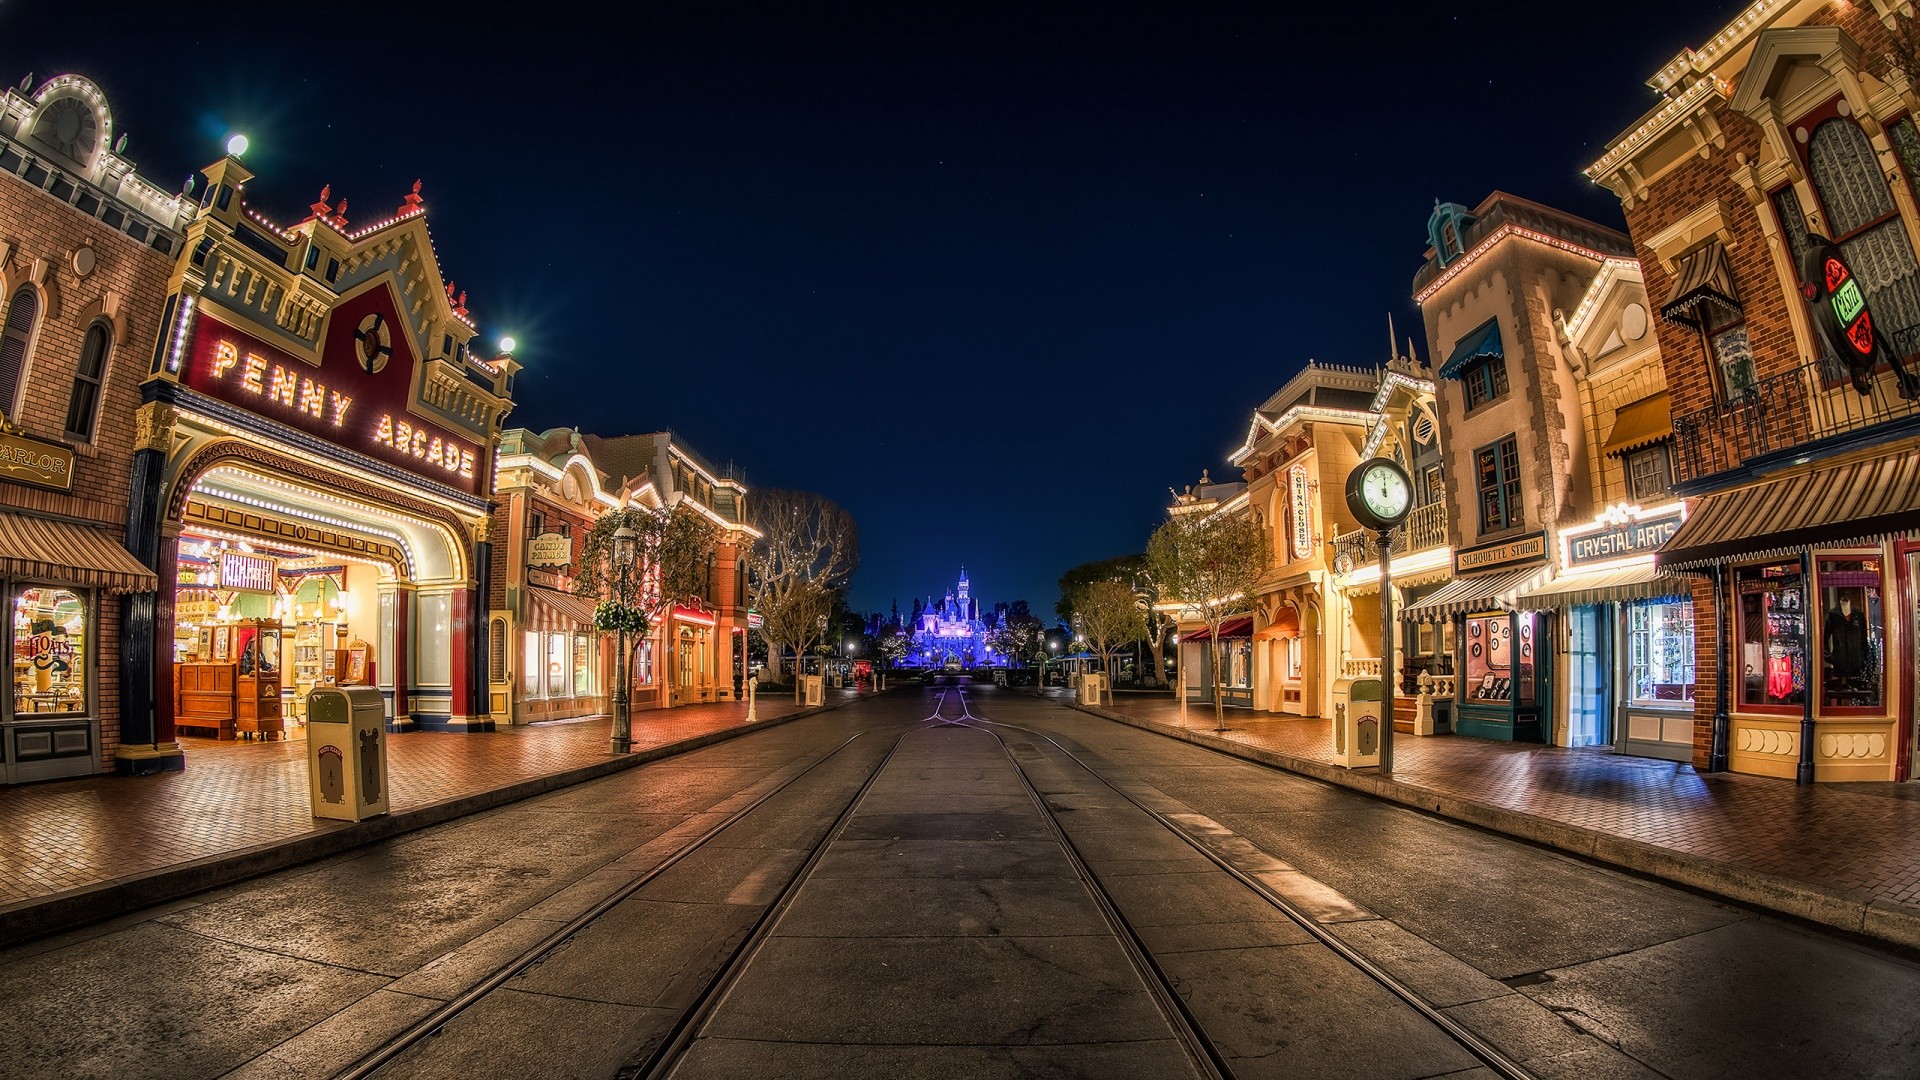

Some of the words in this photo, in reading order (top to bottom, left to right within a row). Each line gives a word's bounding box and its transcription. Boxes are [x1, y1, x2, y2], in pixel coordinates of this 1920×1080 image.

[210, 338, 352, 427] PENNY
[373, 413, 474, 479] ARCADE
[0, 443, 66, 474] ARLOR
[1295, 476, 1304, 507] CHINA
[1297, 509, 1306, 546] CLOSET
[1576, 531, 1633, 559] CRYSTAL
[1637, 521, 1676, 549] ARTS
[531, 551, 567, 560] PALACE
[533, 542, 566, 551] CANDY
[1462, 547, 1507, 567] SILHOUETTE
[1511, 540, 1539, 557] STUDIO
